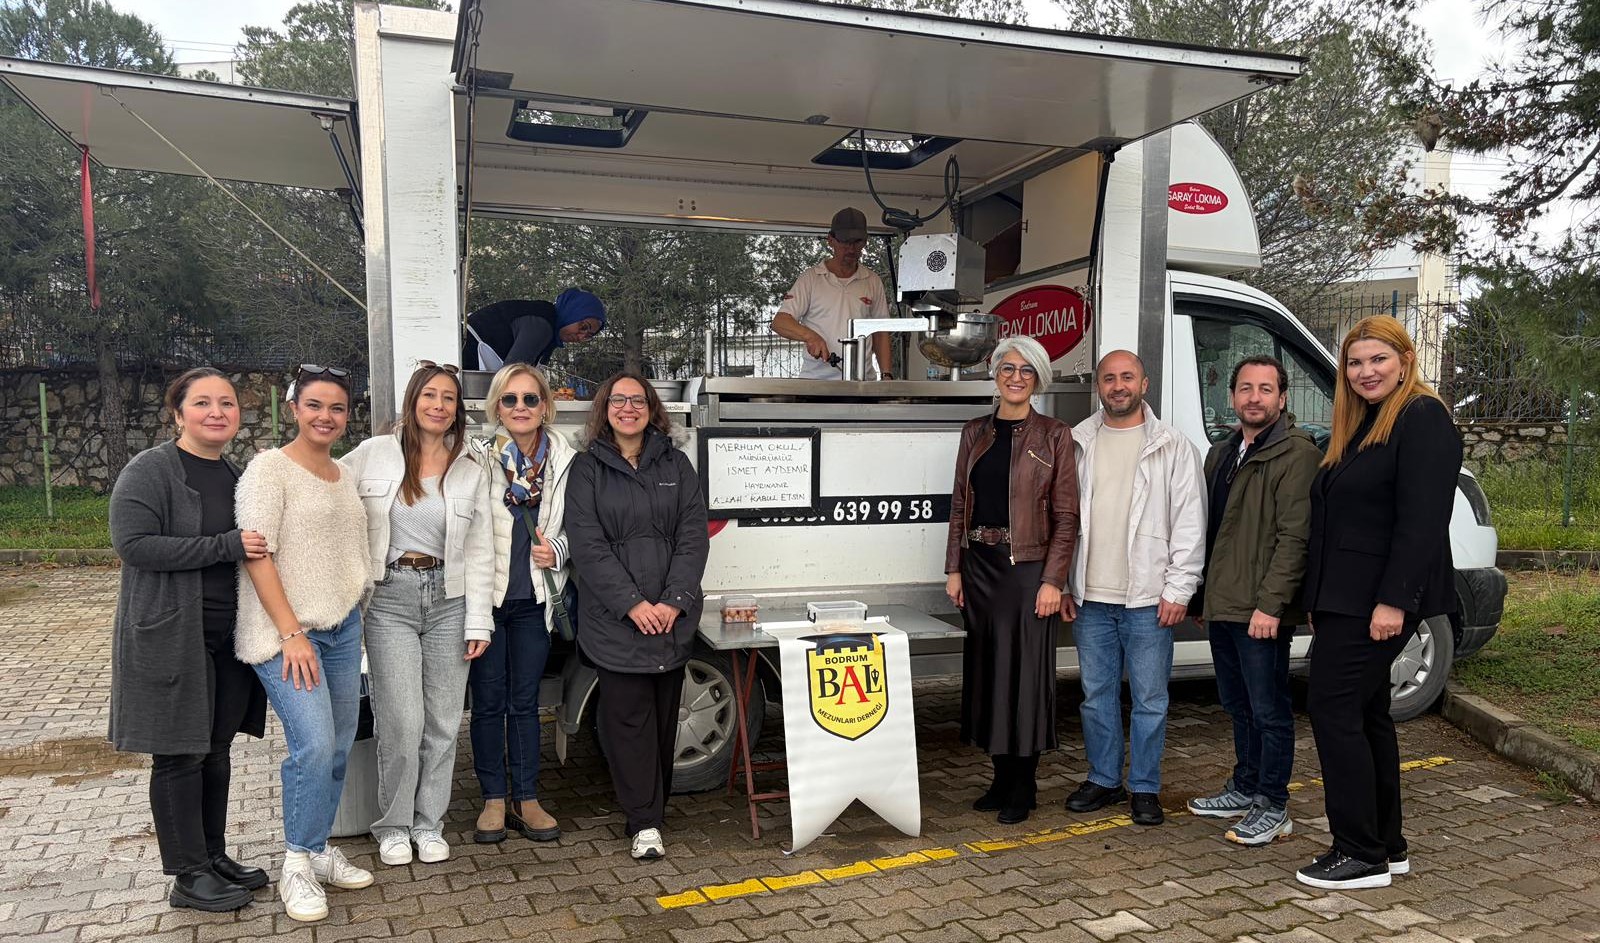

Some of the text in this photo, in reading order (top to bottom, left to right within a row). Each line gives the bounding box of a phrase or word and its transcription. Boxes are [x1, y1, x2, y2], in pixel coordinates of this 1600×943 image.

[1168, 191, 1222, 205] SARAY LOKMA
[1001, 306, 1077, 340] RAY LOKMA
[715, 443, 764, 453] MERHUM
[750, 494, 778, 503] KABUL
[833, 500, 933, 521] 639 99 58
[825, 654, 868, 665] BODRUM
[816, 664, 883, 705] BAL
[817, 708, 856, 724] MEZUNLARI
